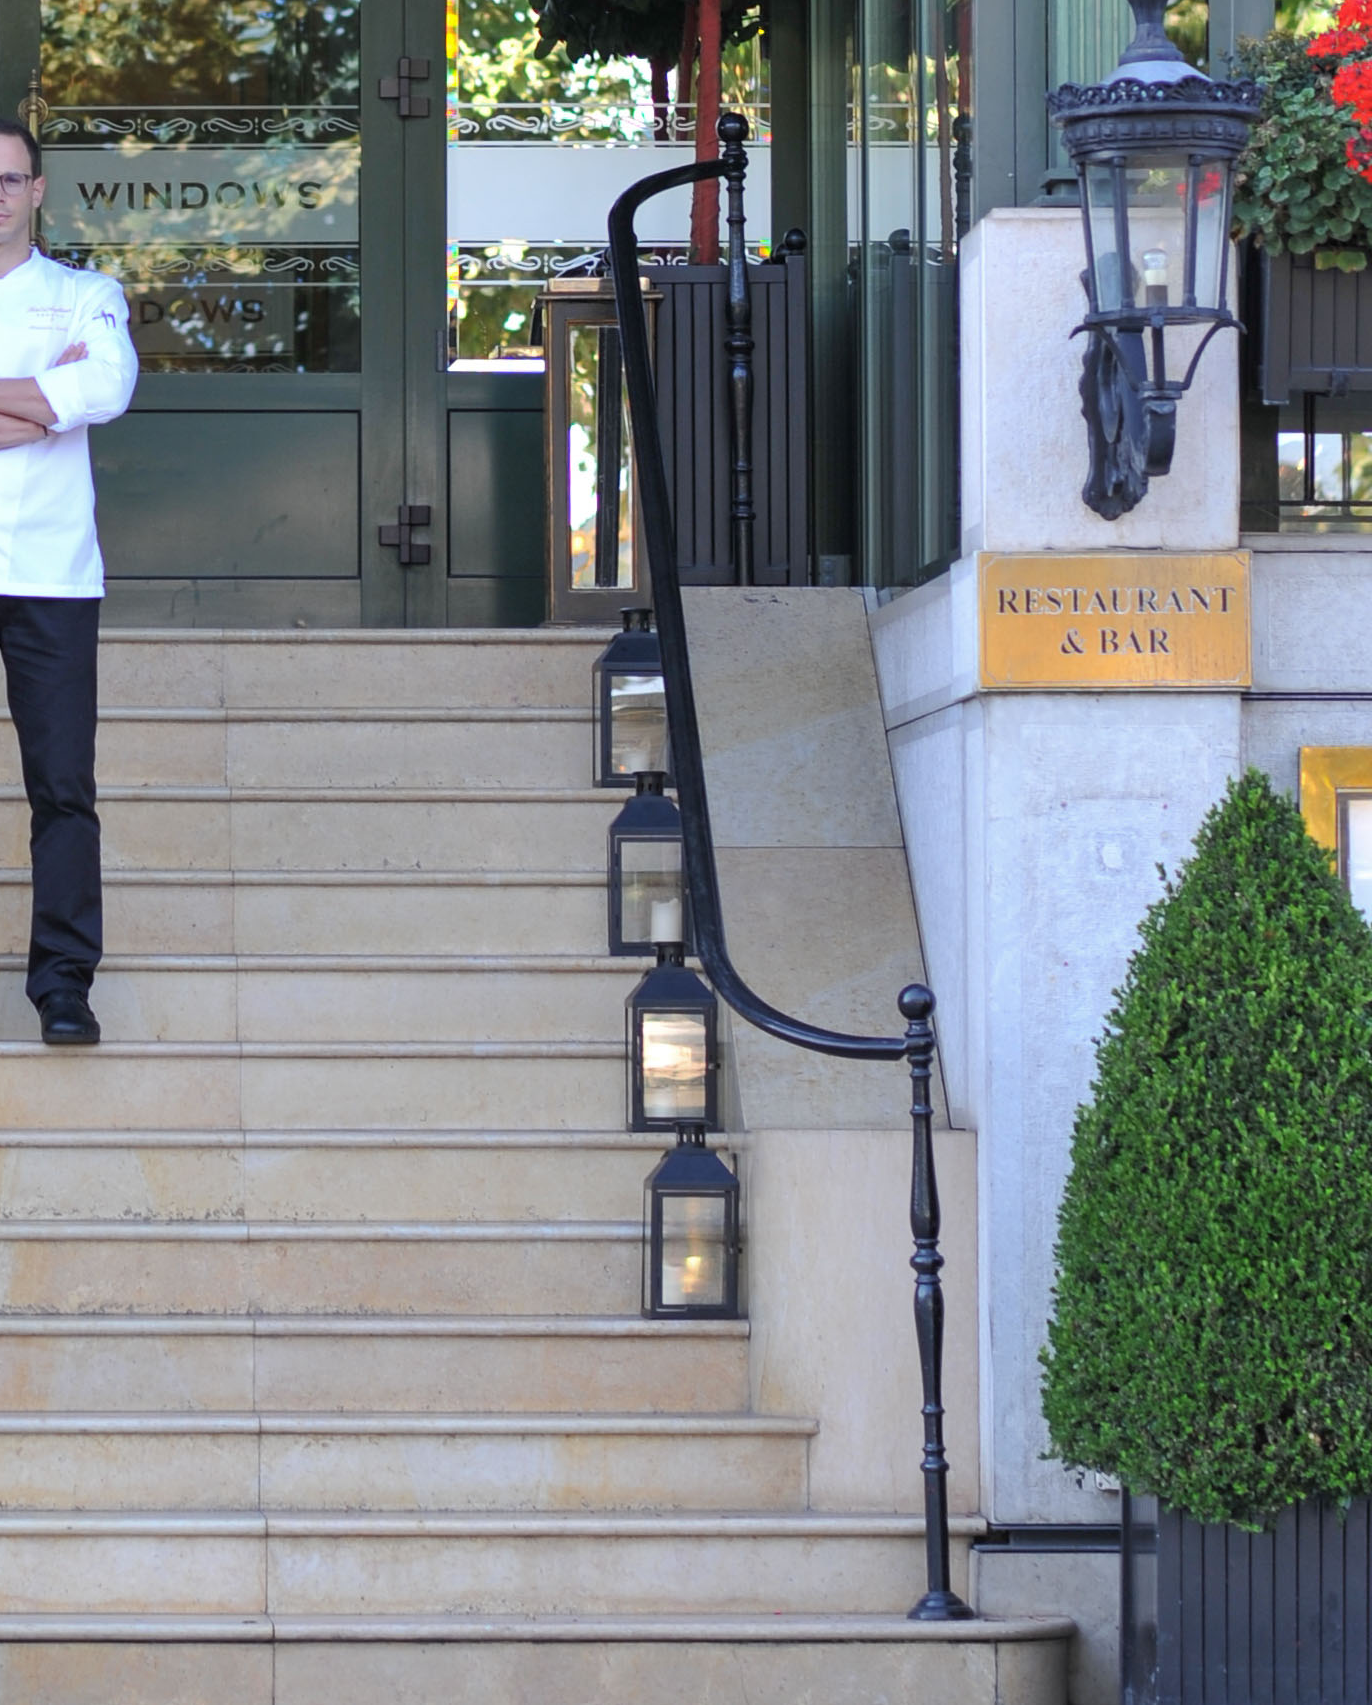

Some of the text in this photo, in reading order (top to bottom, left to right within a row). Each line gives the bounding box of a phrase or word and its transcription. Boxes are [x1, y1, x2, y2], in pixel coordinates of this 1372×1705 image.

[77, 180, 324, 211] WINDOWS
[996, 586, 1237, 615] RESTAURANT
[1059, 627, 1172, 656] & BAR
